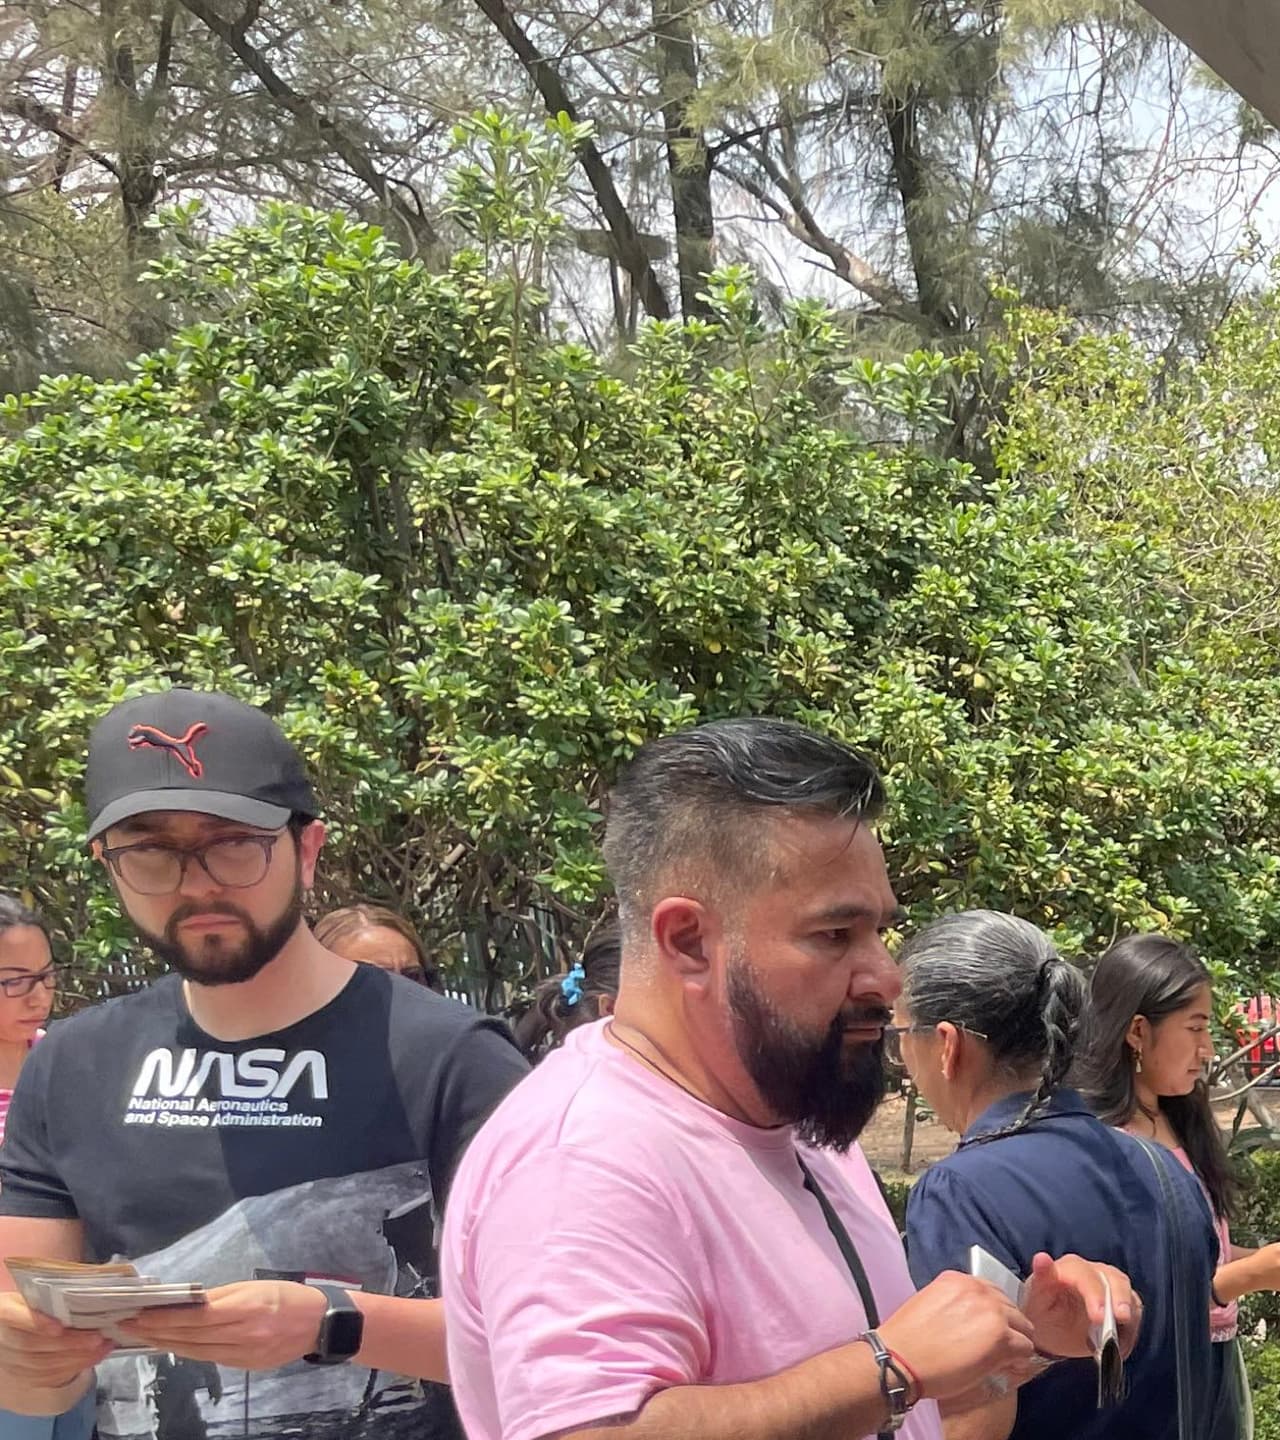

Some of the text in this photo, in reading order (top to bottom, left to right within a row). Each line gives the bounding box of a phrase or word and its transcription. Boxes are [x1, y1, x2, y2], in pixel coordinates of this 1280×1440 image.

[132, 1048, 328, 1099] NASA
[128, 1097, 288, 1113] National Aeronautics
[124, 1112, 323, 1127] and Space Administration
